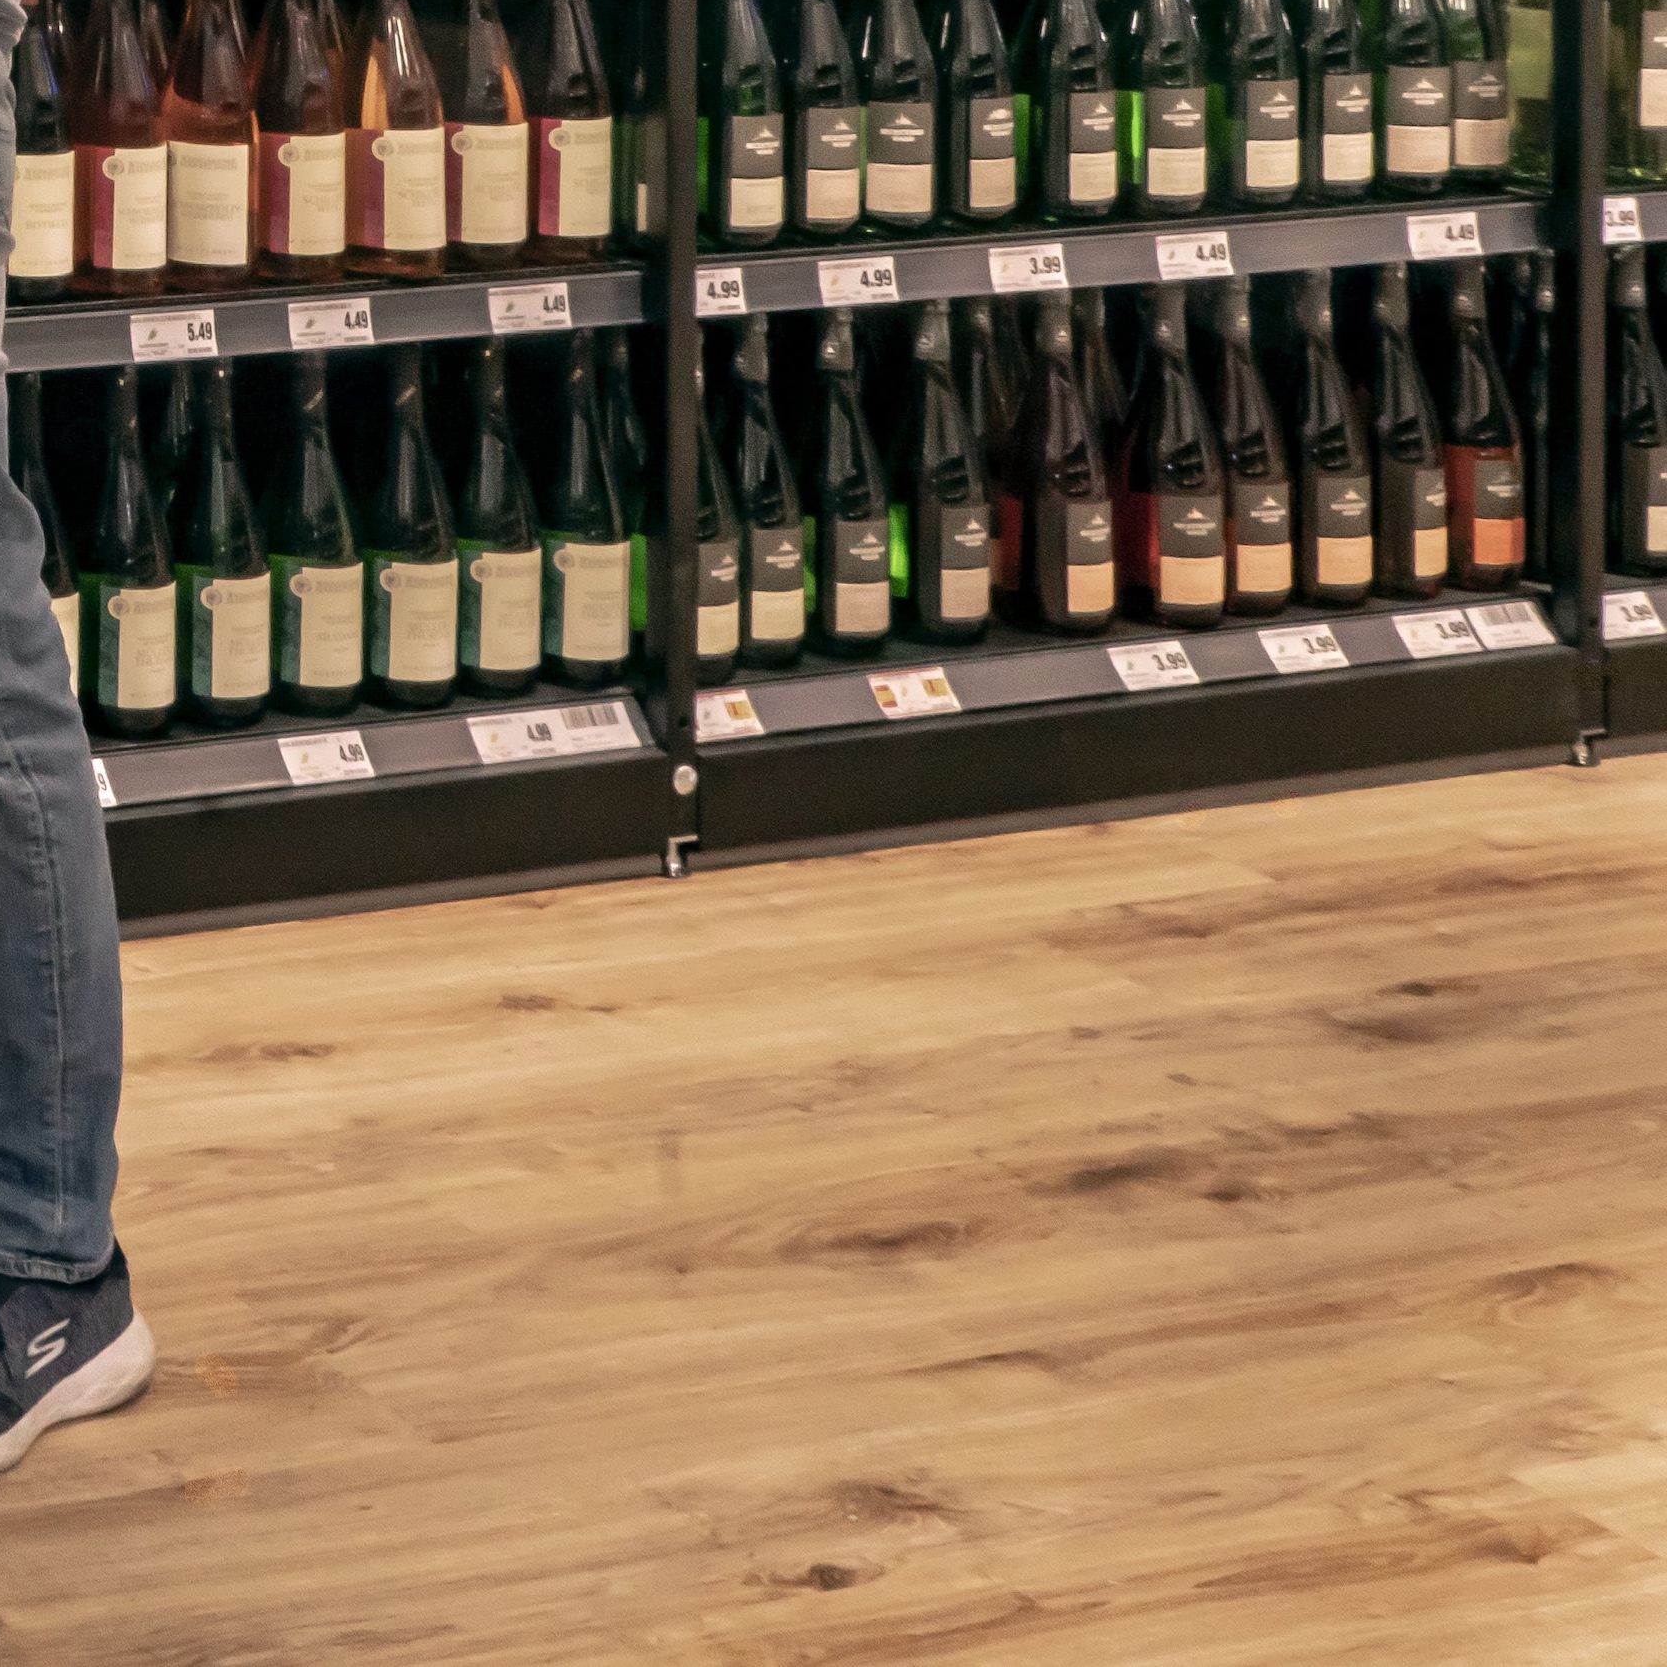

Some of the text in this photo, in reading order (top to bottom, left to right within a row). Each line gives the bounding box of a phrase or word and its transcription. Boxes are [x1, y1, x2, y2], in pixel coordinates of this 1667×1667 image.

[1029, 257, 1061, 275] 3.99
[861, 269, 892, 288] 4.99
[707, 281, 740, 299] 4.99
[543, 294, 566, 314] 4.49
[344, 310, 368, 330] 4.49
[187, 322, 213, 341] 5.49
[526, 723, 552, 743] 4.99
[339, 743, 364, 764] 4.99
